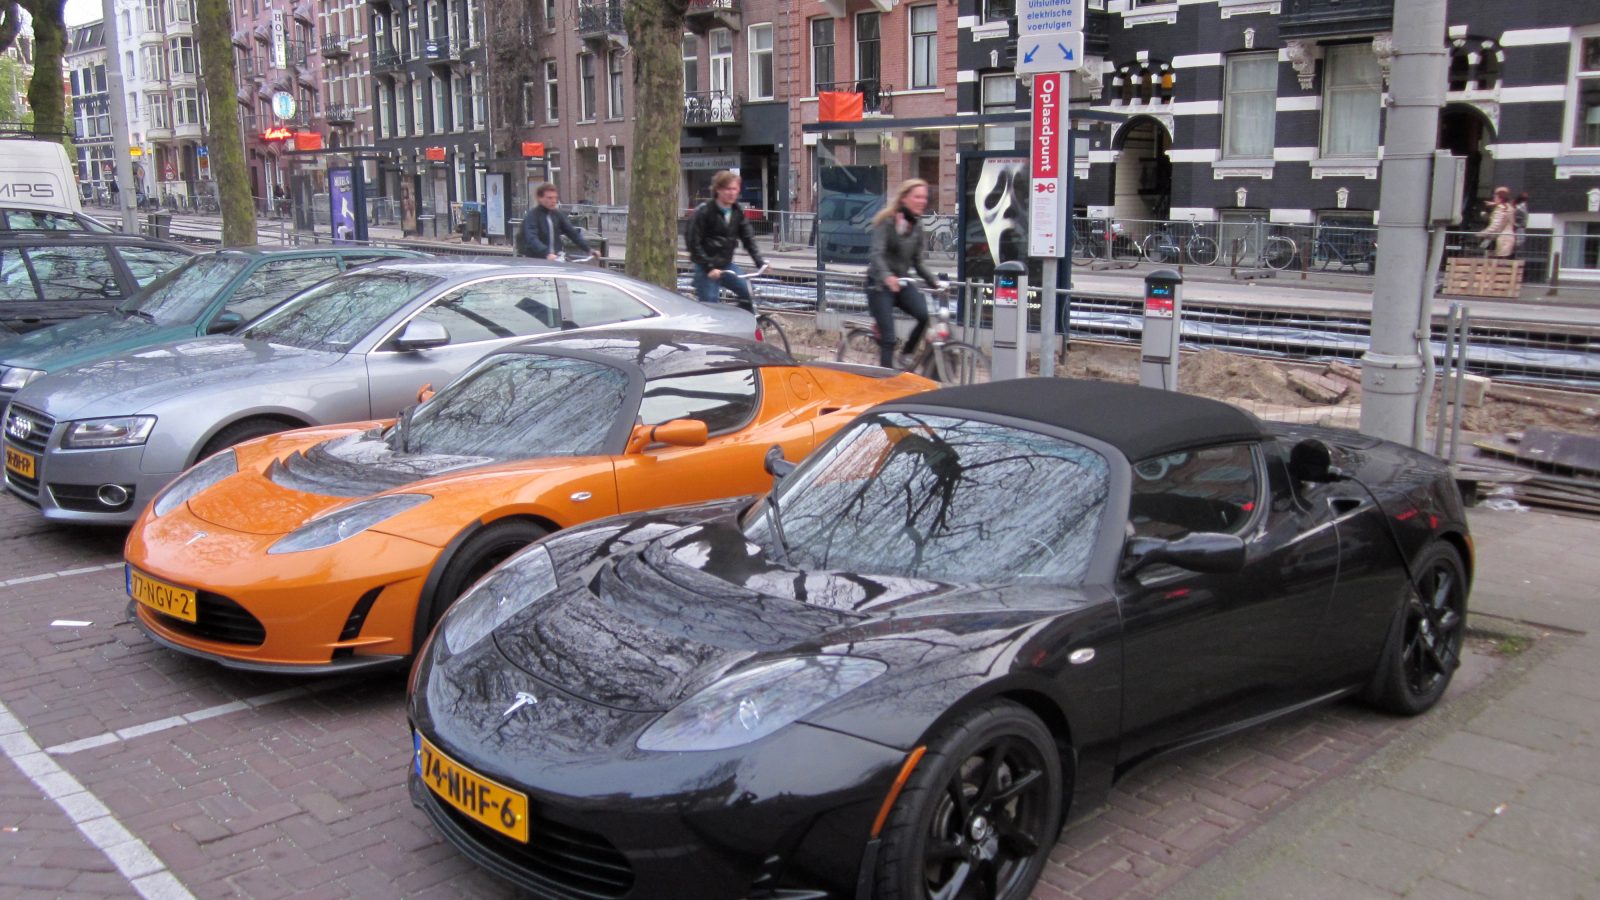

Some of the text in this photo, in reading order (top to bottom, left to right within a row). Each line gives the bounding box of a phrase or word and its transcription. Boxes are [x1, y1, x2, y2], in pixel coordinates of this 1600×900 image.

[274, 13, 284, 62] HOTEL
[1027, 9, 1073, 20] elektrische
[1027, 21, 1072, 31] voertuigen
[1039, 80, 1055, 172] Oplaadpunt
[132, 573, 190, 616] 77-NGV-2
[423, 746, 516, 829] 74-NHF-6
